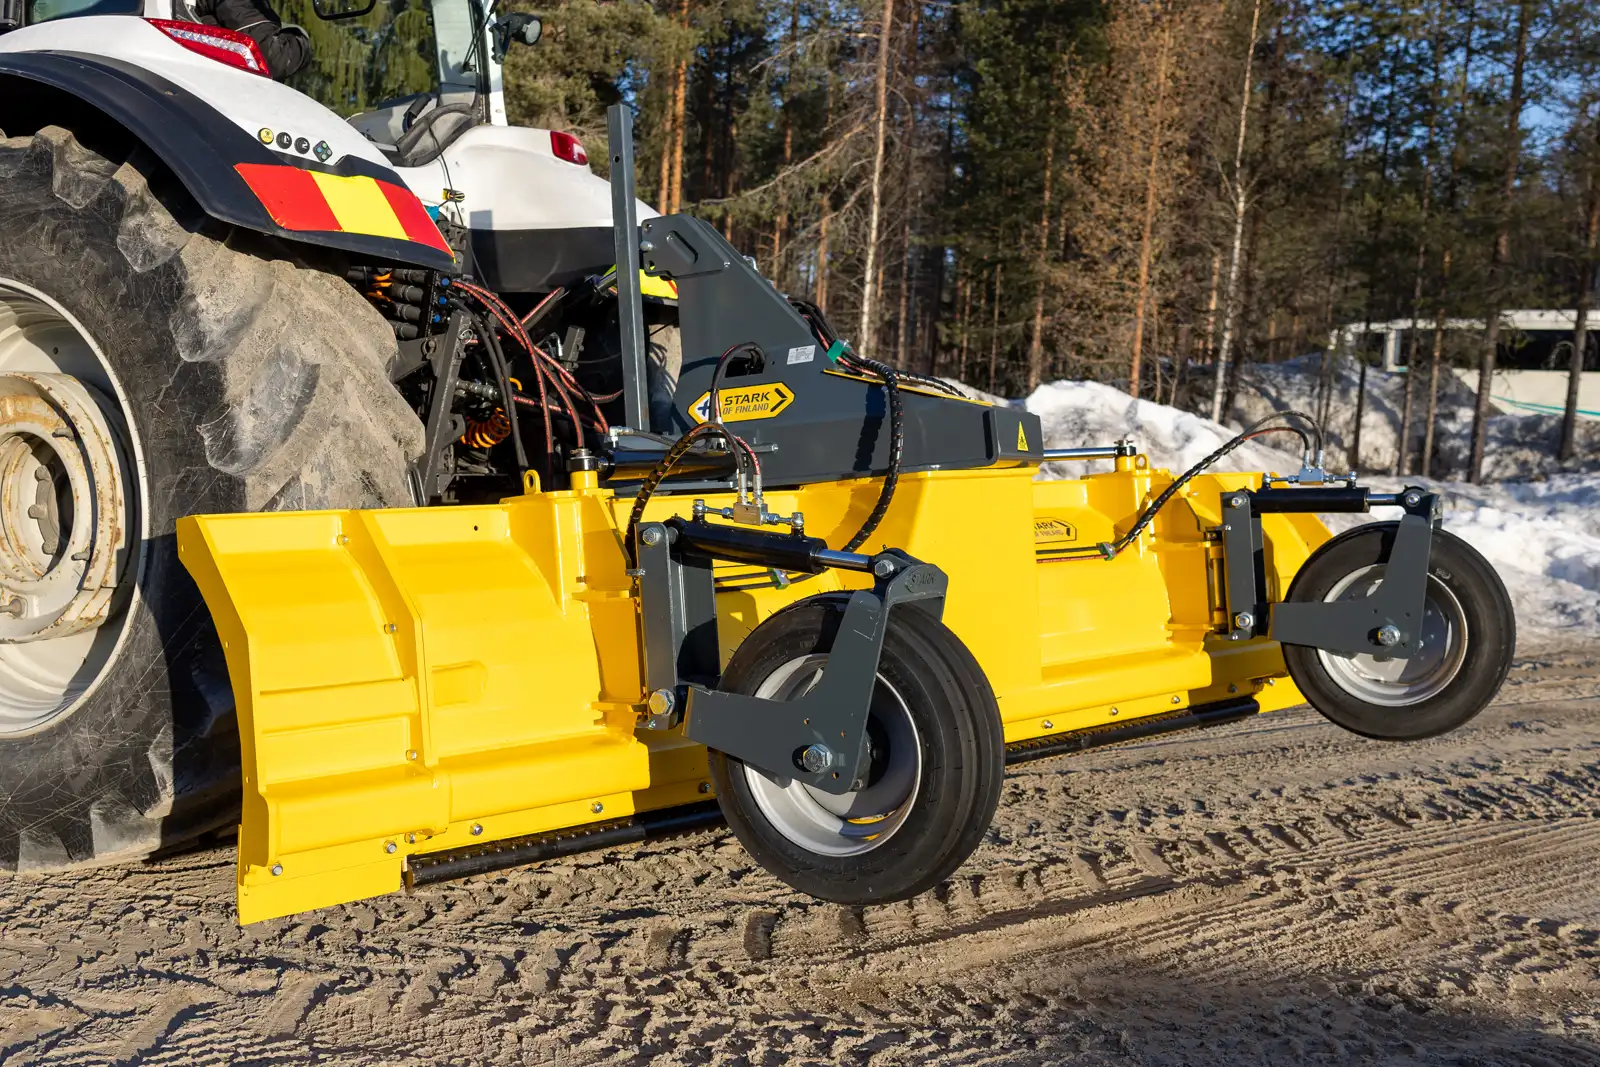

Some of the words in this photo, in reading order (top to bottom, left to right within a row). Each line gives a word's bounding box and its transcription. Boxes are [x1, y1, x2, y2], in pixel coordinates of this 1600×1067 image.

[724, 392, 771, 406] STARK
[722, 407, 733, 415] OF
[735, 402, 769, 414] FINLAND
[1034, 521, 1058, 530] ARK
